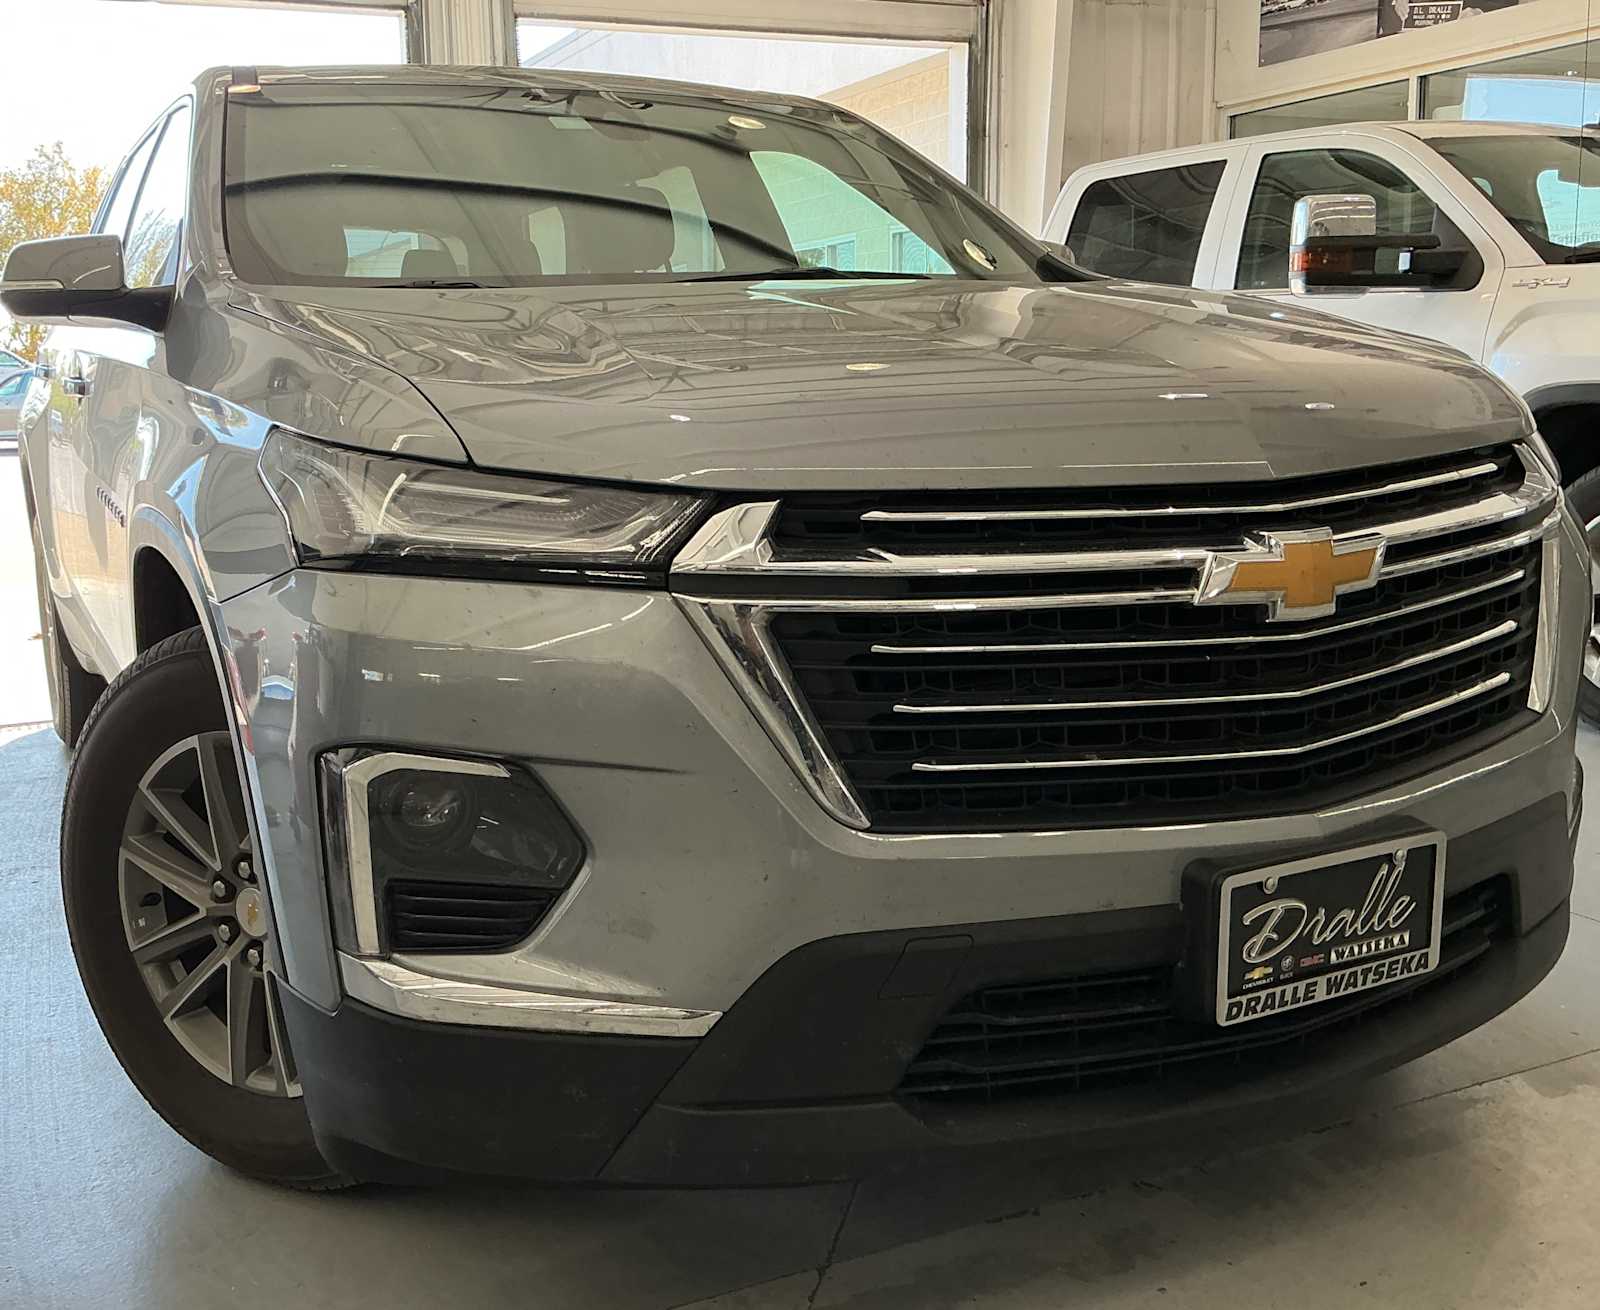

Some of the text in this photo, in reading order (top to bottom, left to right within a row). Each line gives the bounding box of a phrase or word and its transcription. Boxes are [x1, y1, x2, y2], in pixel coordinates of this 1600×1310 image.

[1428, 5, 1453, 14] DRALLE
[1242, 862, 1416, 964] Dralle
[1334, 933, 1407, 962] WATSEKA
[1225, 951, 1429, 1021] DRALLE WATSEKA
